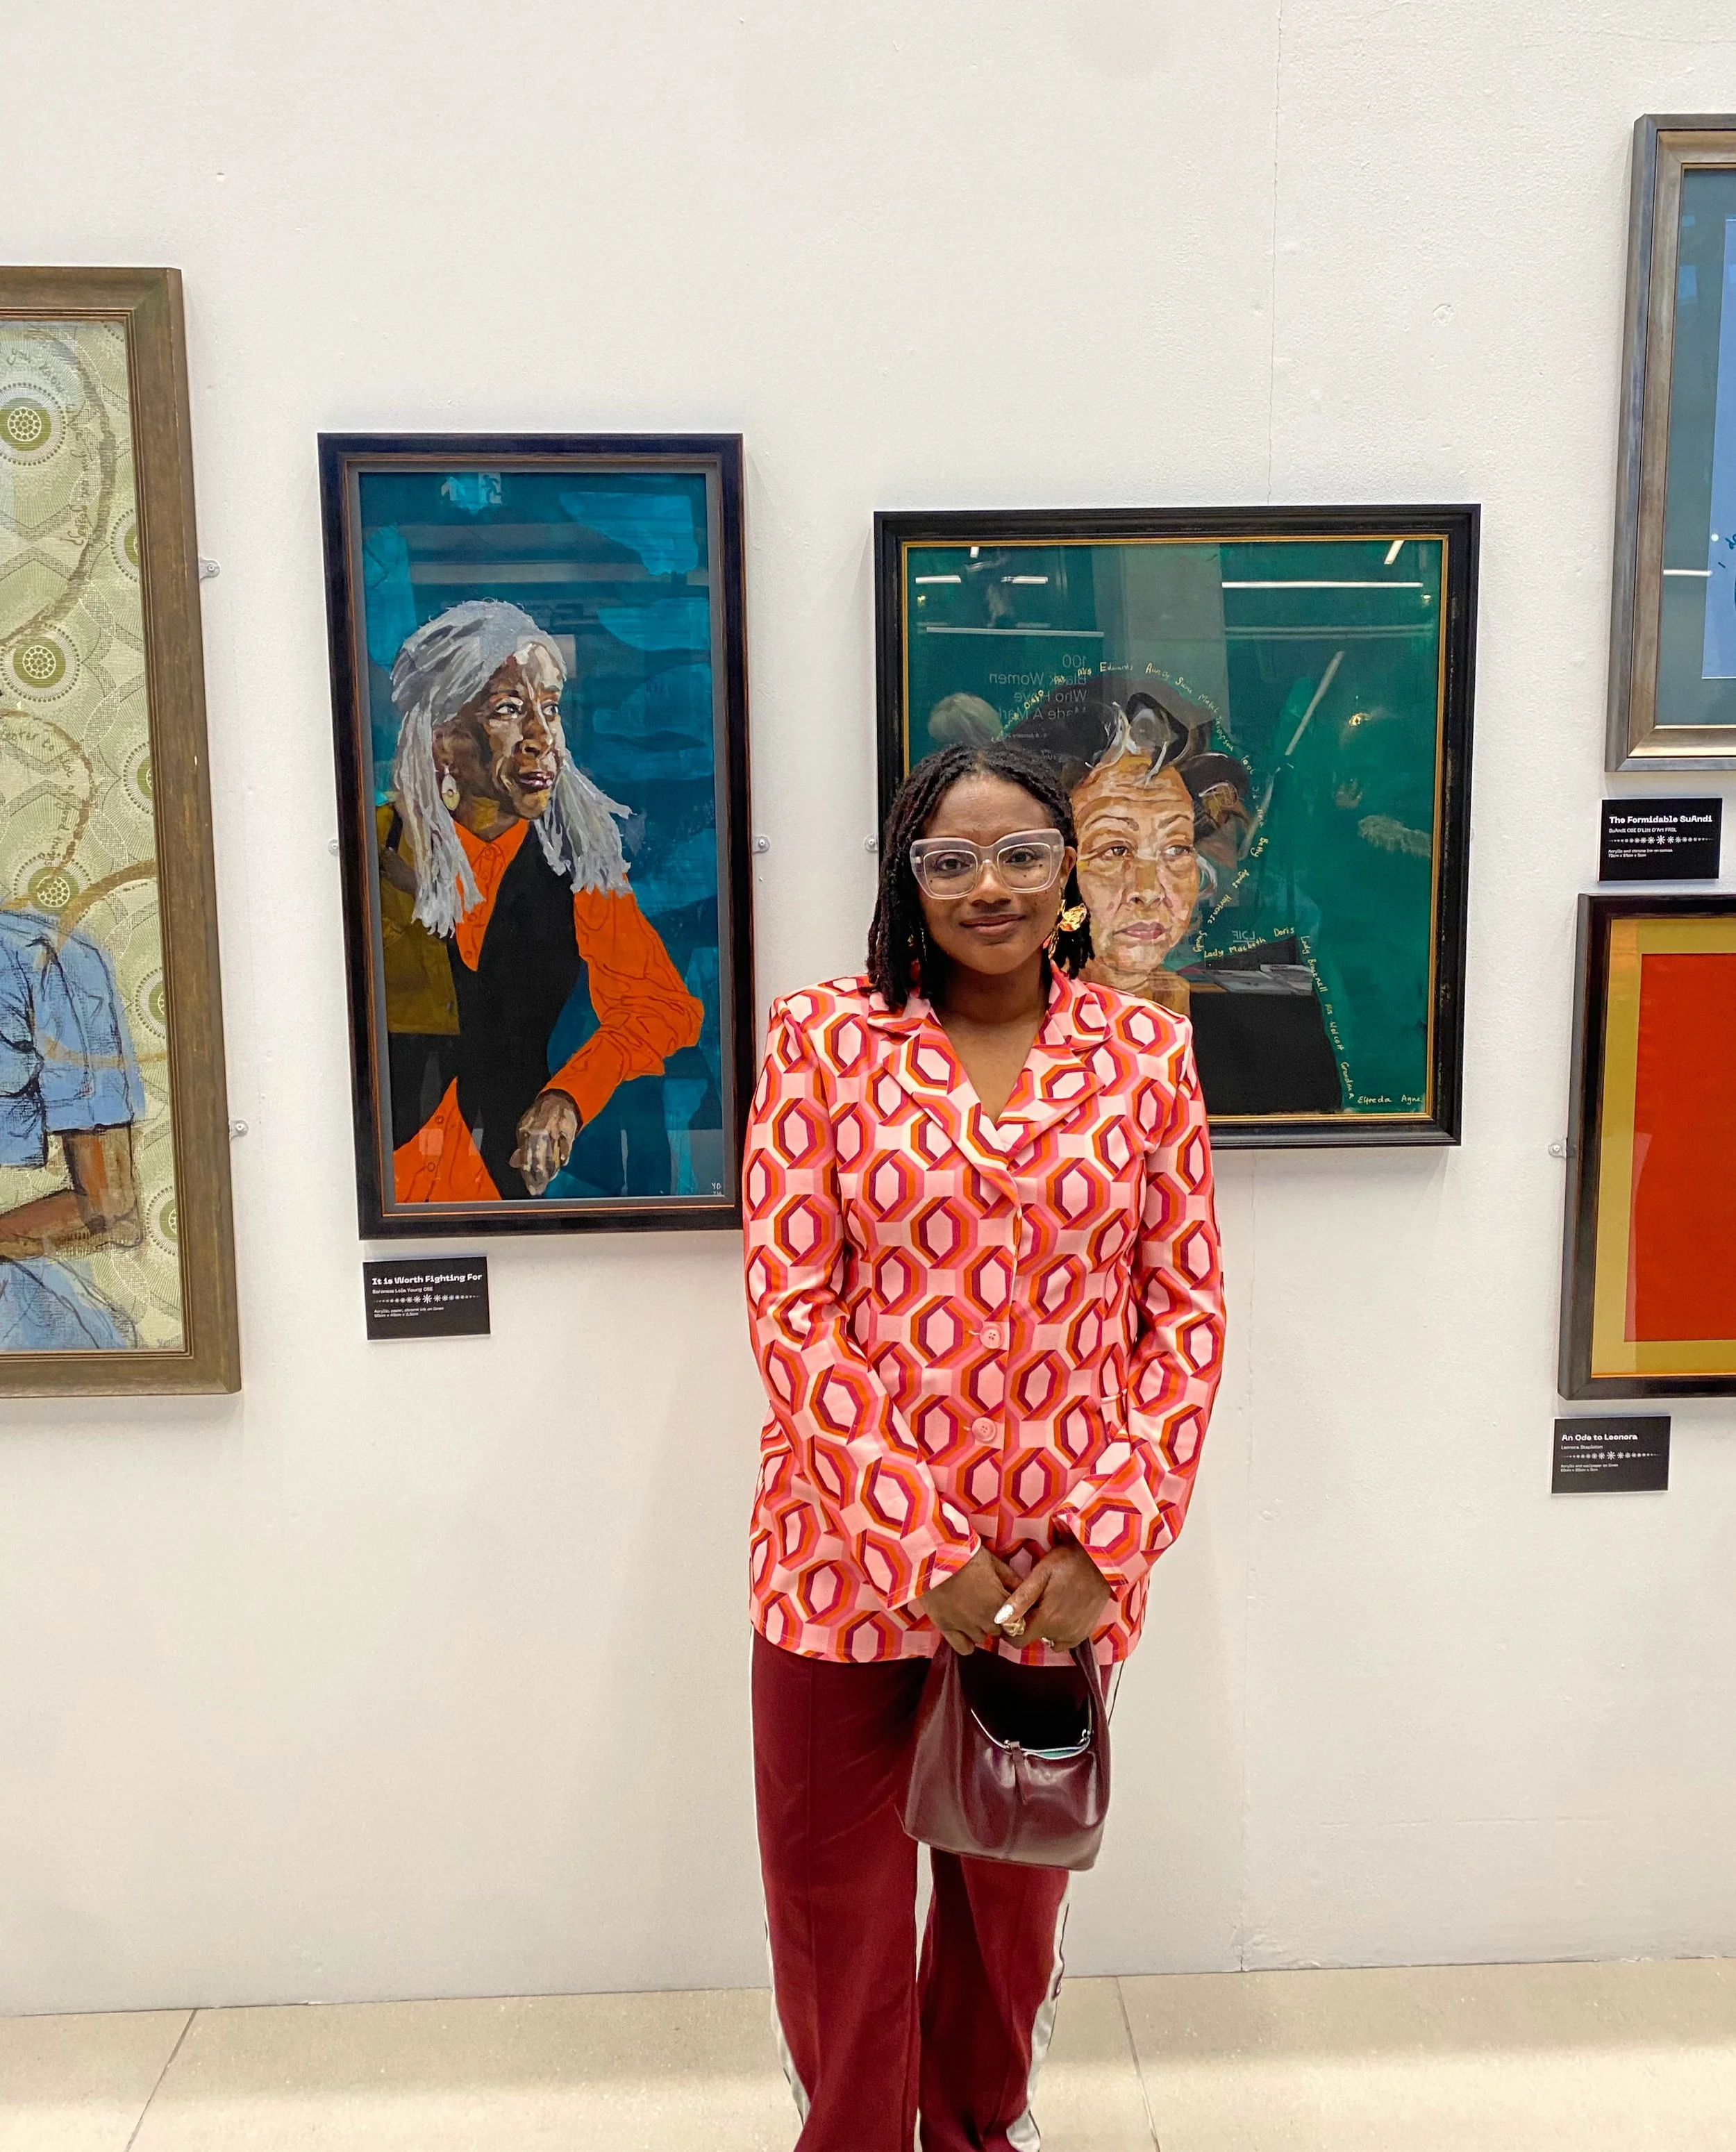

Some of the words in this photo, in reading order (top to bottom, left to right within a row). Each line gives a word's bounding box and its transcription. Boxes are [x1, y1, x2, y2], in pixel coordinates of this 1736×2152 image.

[1609, 815, 1626, 824] The
[1627, 815, 1678, 824] Formidable
[1680, 815, 1712, 823] SuAndi
[1250, 837, 1269, 858] Betty
[1273, 927, 1296, 937] Doris
[1204, 948, 1224, 958] Lady
[1228, 937, 1267, 953] Macbeth
[1300, 935, 1311, 954] Lady
[372, 1277, 383, 1285] It
[383, 1277, 394, 1285] is
[394, 1276, 424, 1284] Worth
[425, 1274, 466, 1284] Fighting
